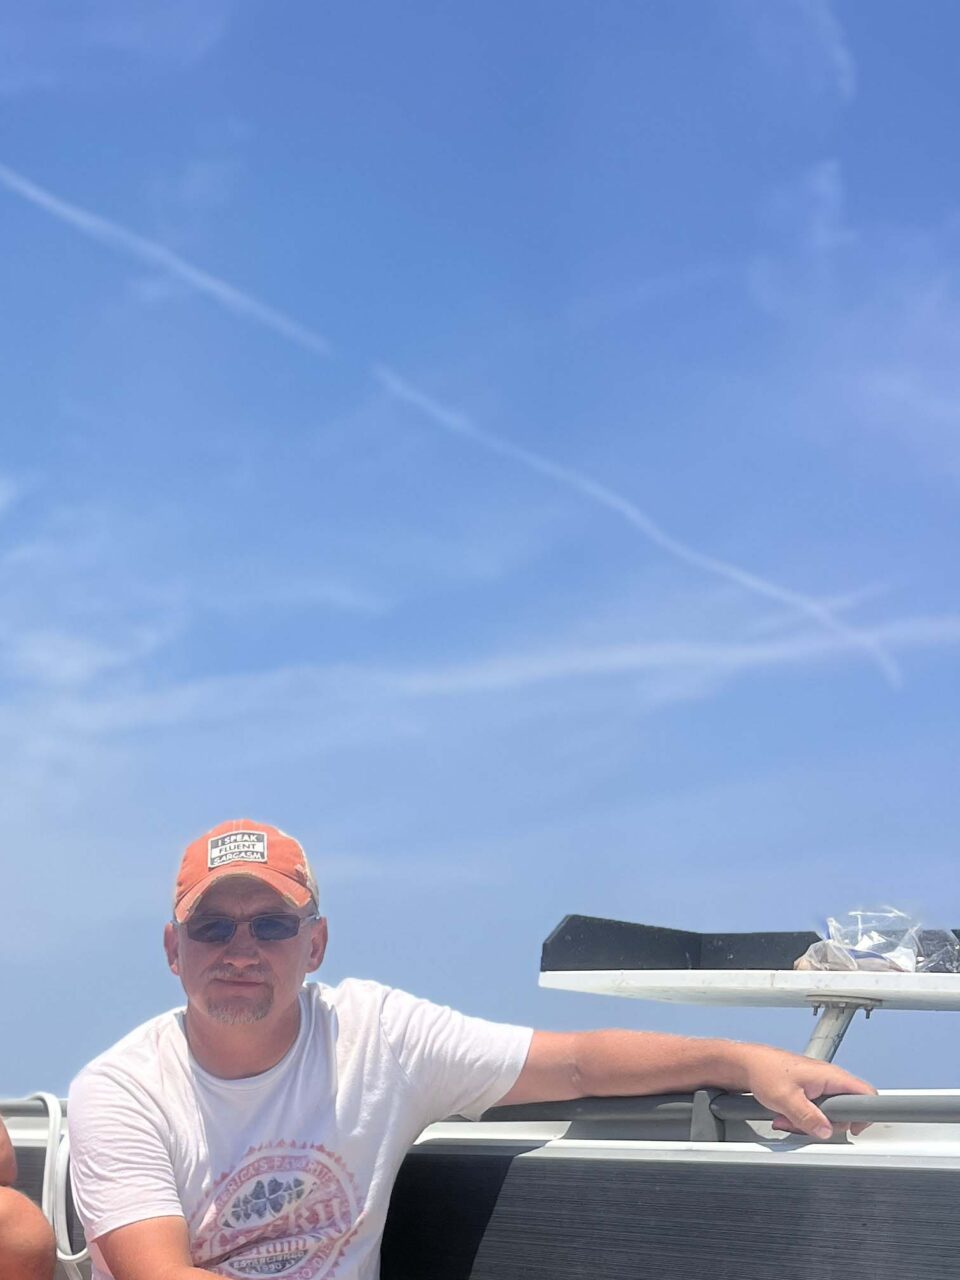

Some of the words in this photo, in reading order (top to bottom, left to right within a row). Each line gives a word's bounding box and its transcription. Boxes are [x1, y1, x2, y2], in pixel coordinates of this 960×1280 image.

[224, 834, 258, 845] SPEAK
[219, 843, 257, 854] FLUENT
[213, 852, 262, 865] SARCASM
